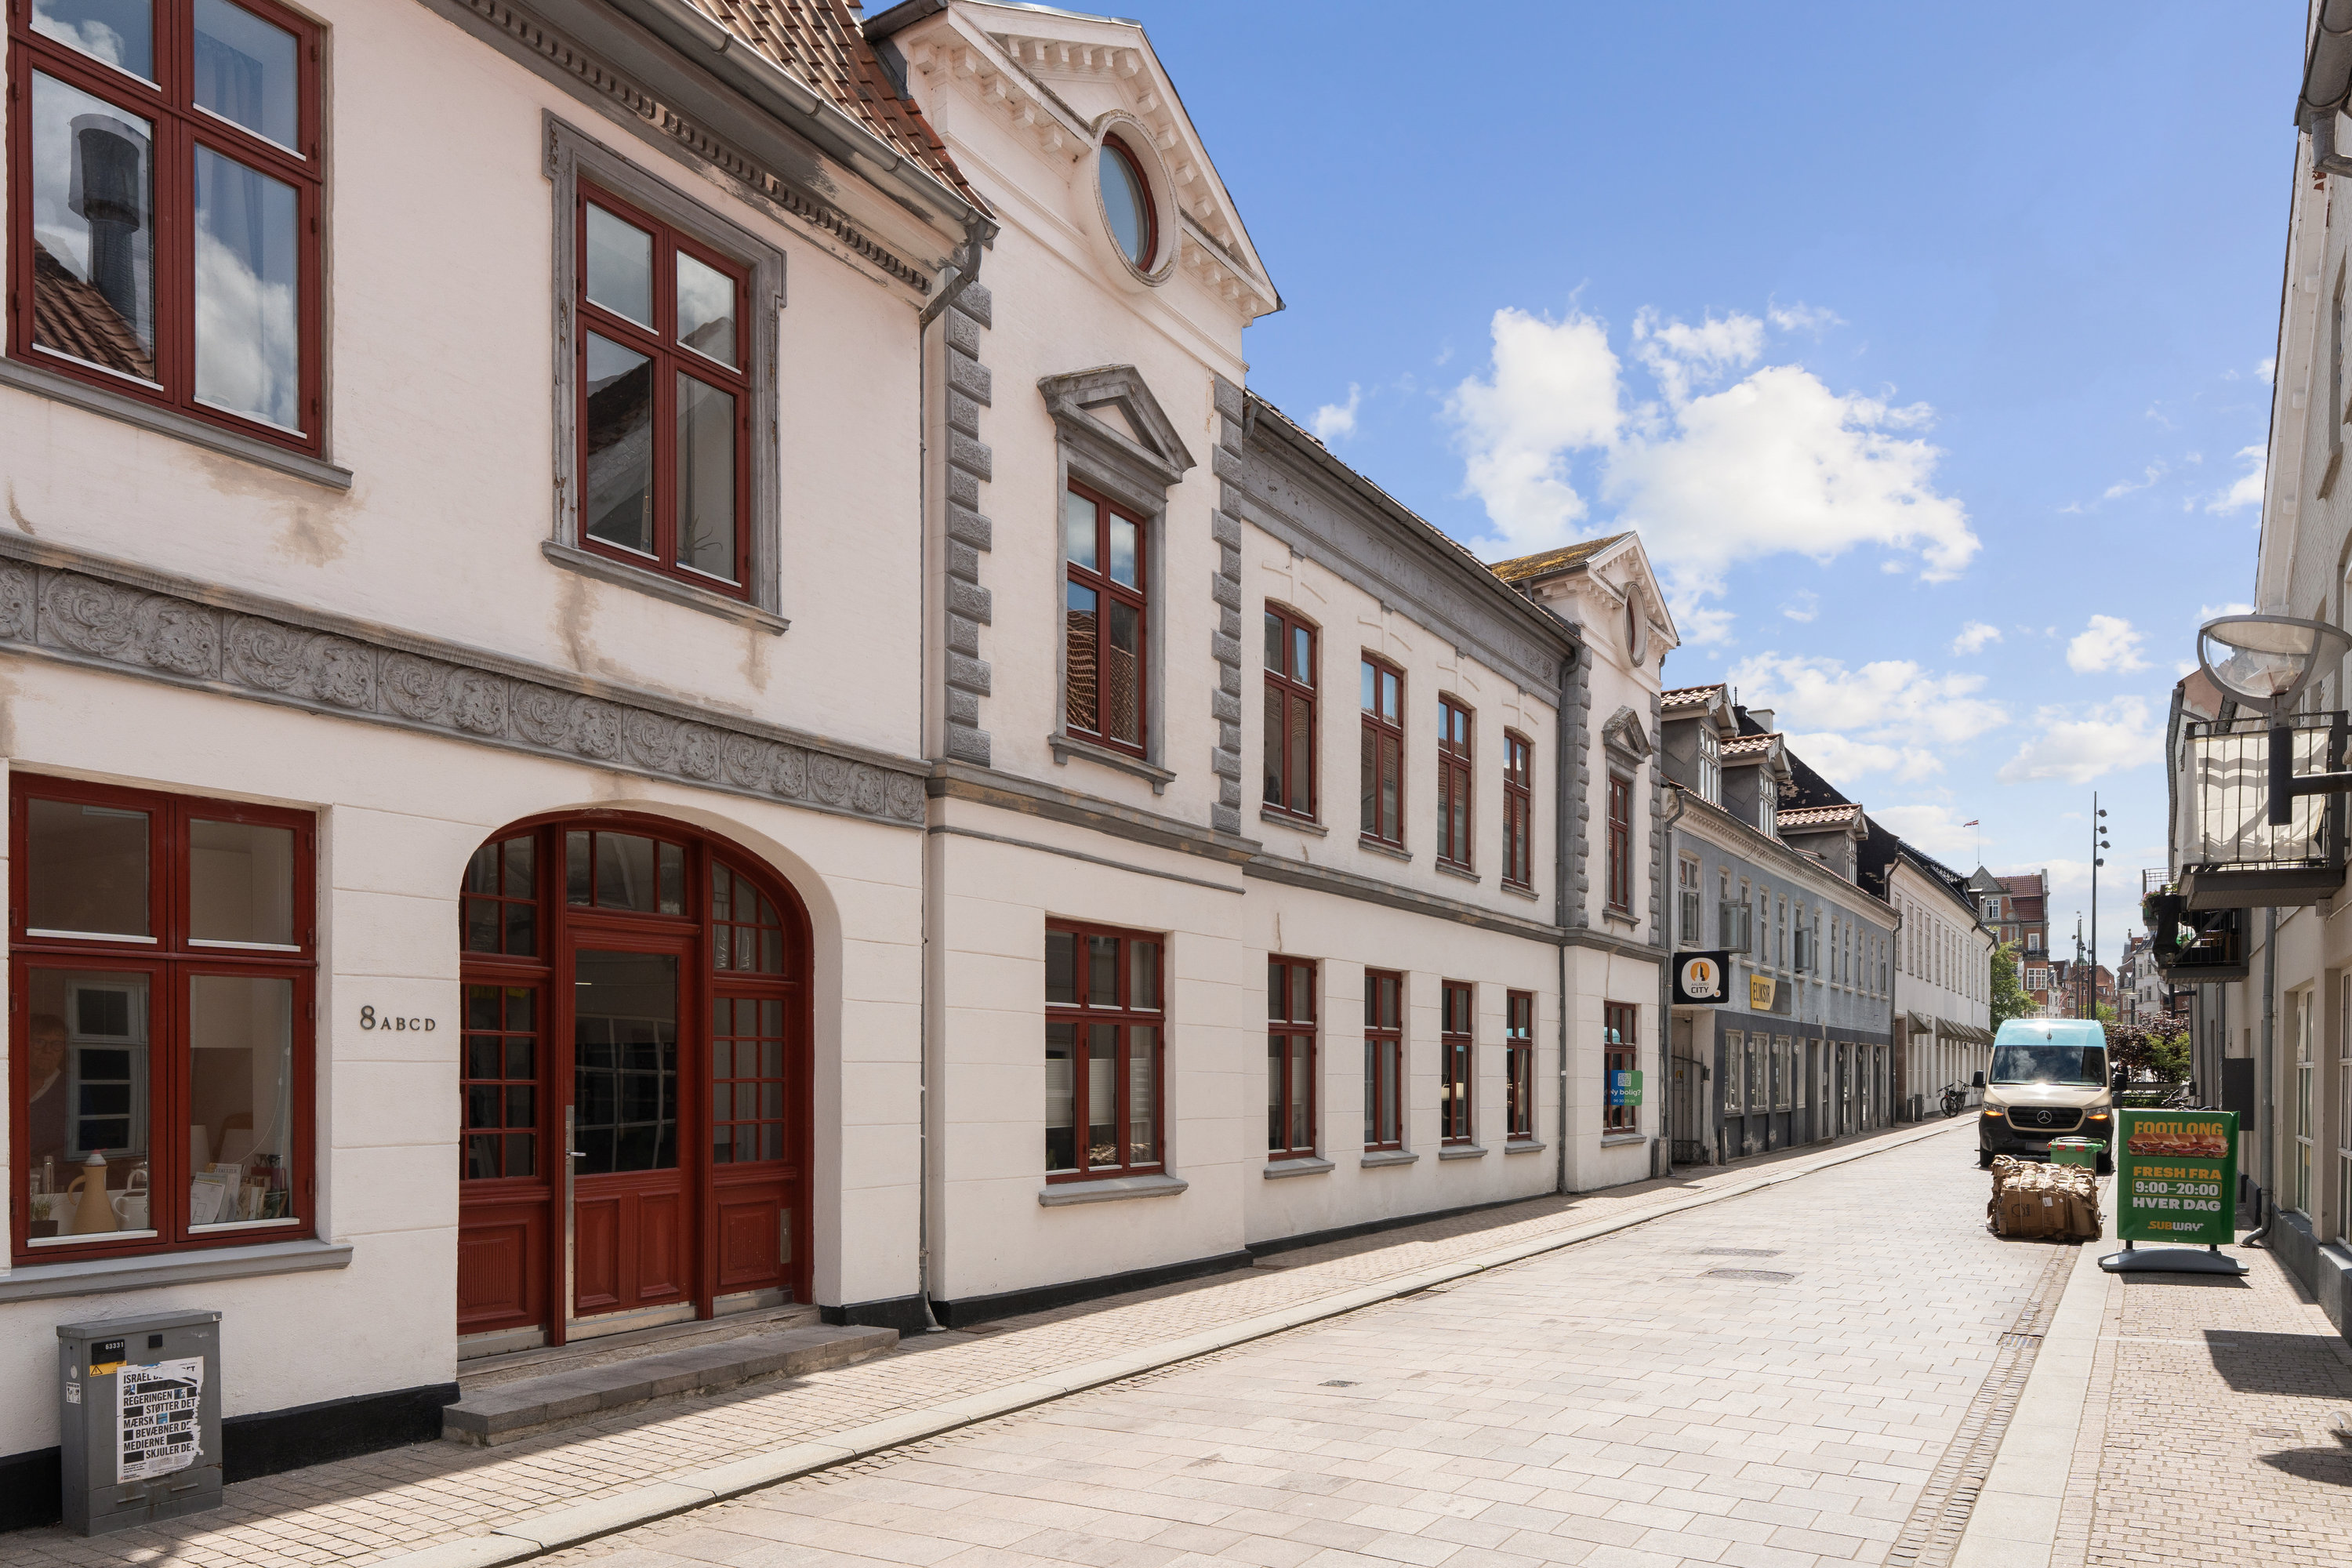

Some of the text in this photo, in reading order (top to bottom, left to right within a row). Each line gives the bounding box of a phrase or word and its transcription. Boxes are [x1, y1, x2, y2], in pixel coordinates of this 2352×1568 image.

[2134, 1121, 2223, 1136] FOOTLONG
[2133, 1166, 2222, 1180] FRESH FRA
[2132, 1197, 2221, 1212] HVER DAG
[2147, 1221, 2204, 1232] SUBWAY
[105, 1341, 124, 1350] 63331
[123, 1373, 151, 1385] ISRAEL
[123, 1390, 172, 1406] REGERINGEN
[146, 1398, 196, 1414] STØTTER DET
[123, 1415, 154, 1429] MÆRSK
[136, 1423, 180, 1439] BEVÆBNER
[123, 1436, 165, 1452] MEDIERNE
[146, 1445, 180, 1459] SKJULER
